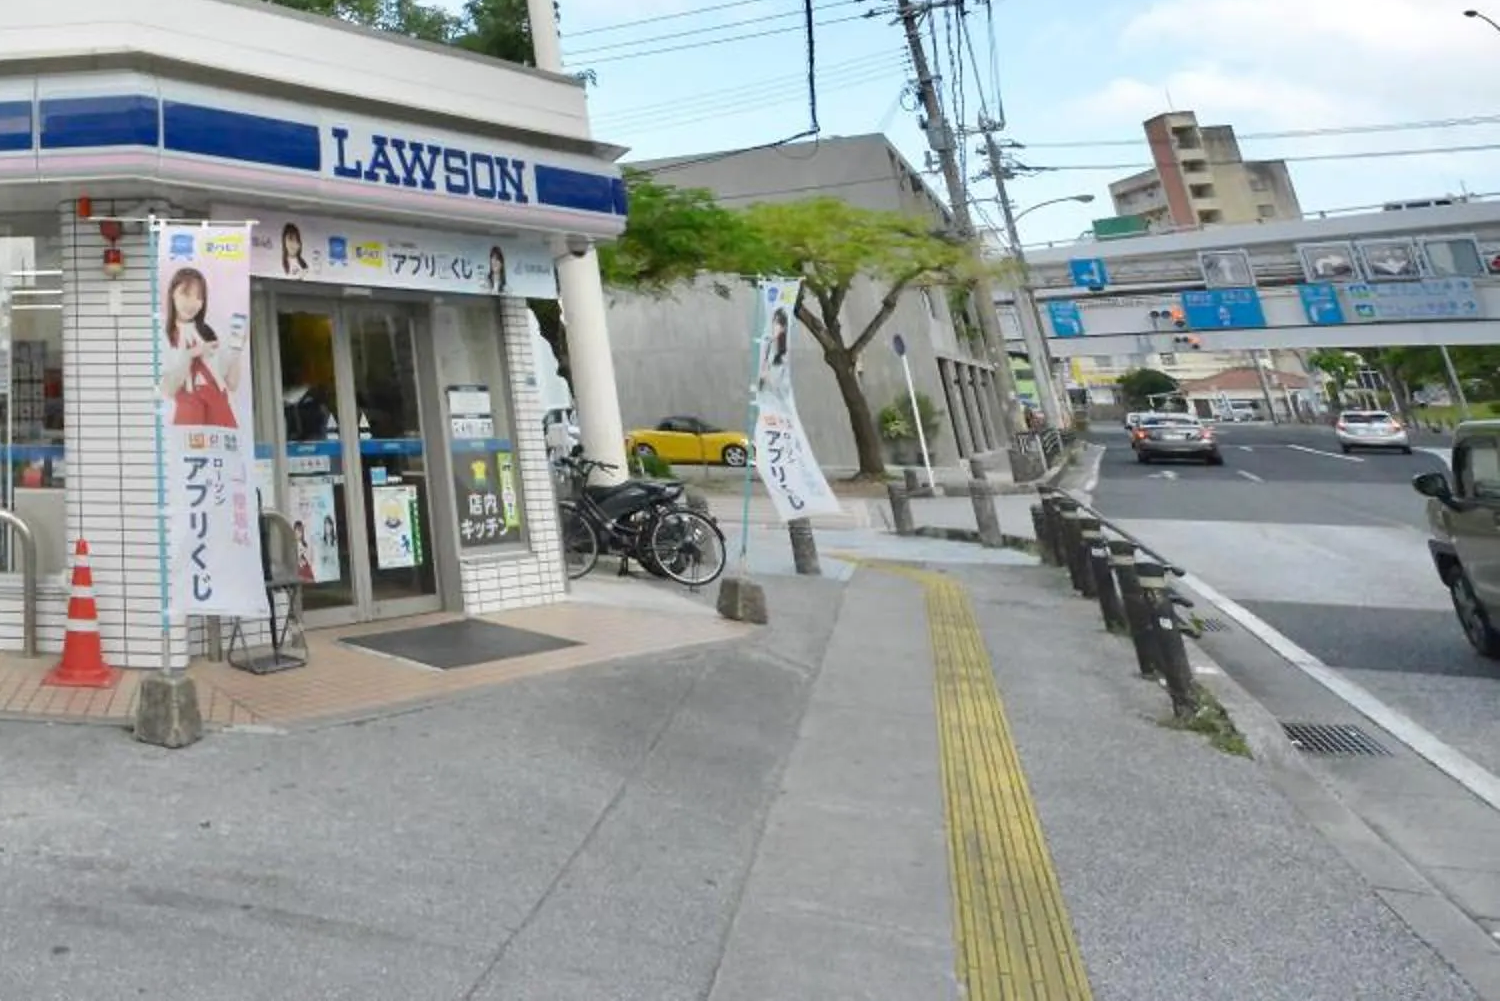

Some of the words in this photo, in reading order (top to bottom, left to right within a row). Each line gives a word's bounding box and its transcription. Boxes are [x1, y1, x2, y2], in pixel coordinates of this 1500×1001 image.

[331, 126, 529, 204] LAWSON
[183, 456, 213, 602] アプリくじ
[461, 517, 508, 541] キッチン
[468, 492, 499, 515] 店内
